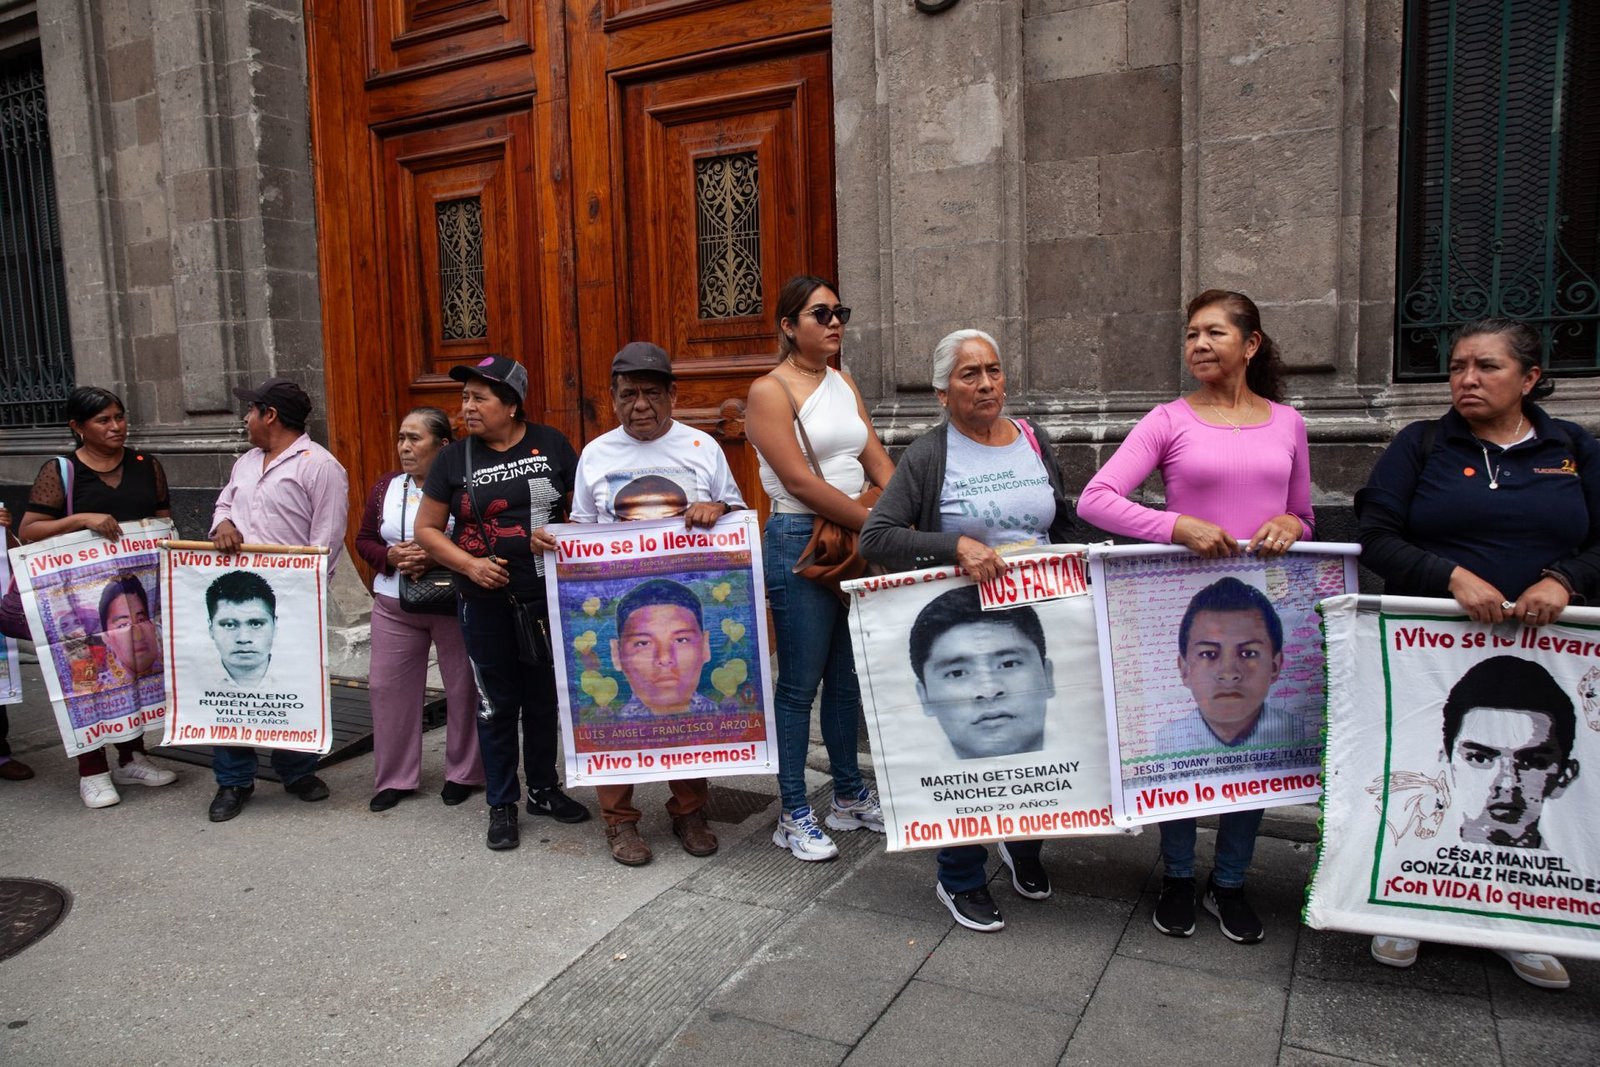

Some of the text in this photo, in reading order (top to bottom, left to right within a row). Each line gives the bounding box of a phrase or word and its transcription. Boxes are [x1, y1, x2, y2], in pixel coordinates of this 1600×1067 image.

[518, 456, 548, 465] OLVIDO
[953, 469, 1016, 490] TE BUSCARÉ
[957, 485, 992, 498] HASTA
[558, 527, 746, 563] ¡Vivo se lo llevaron!
[30, 553, 74, 577] ¡Vivo
[79, 548, 99, 562] se
[102, 541, 118, 556] lo
[173, 551, 316, 569] ¡Vivo se lo llevaron!
[980, 566, 1018, 607] NOS
[1020, 555, 1087, 600] FALTAN
[1395, 627, 1455, 651] ¡Vivo
[1461, 632, 1486, 649] se
[199, 698, 304, 709] RUBÉN LAURO
[204, 690, 298, 700] MAGDALENO
[215, 708, 287, 717] VILLEGAS
[216, 716, 289, 725] EDAD 19 AÑOS
[85, 721, 124, 744] ¡Vivo
[127, 716, 140, 729] lo
[179, 725, 317, 743] ¡Con VIDA lo queremos!
[653, 721, 714, 736] FRANCISCO
[587, 744, 756, 775] ¡Vivo lo queremos!
[1133, 761, 1165, 776] JESÚS
[1171, 758, 1210, 771] JOVANY
[1216, 750, 1277, 765] RODRÍGUEZ
[920, 761, 1080, 788] MARTÍN GETSEMANY
[933, 777, 1073, 802] SÁNCHEZ GARCÍA
[1136, 787, 1189, 815] ¡Vivo
[1195, 783, 1215, 802] lo
[956, 798, 1059, 815] EDAD 20 AÑOS
[904, 804, 1115, 845] ¡Con VIDA lo queremos!
[1400, 860, 1492, 881] GONZÁLEZ
[1436, 845, 1571, 873] CÉSAR MANUEL
[1384, 876, 1428, 897] ¡Con
[1433, 879, 1481, 902] VIDA
[1486, 885, 1504, 904] lo
